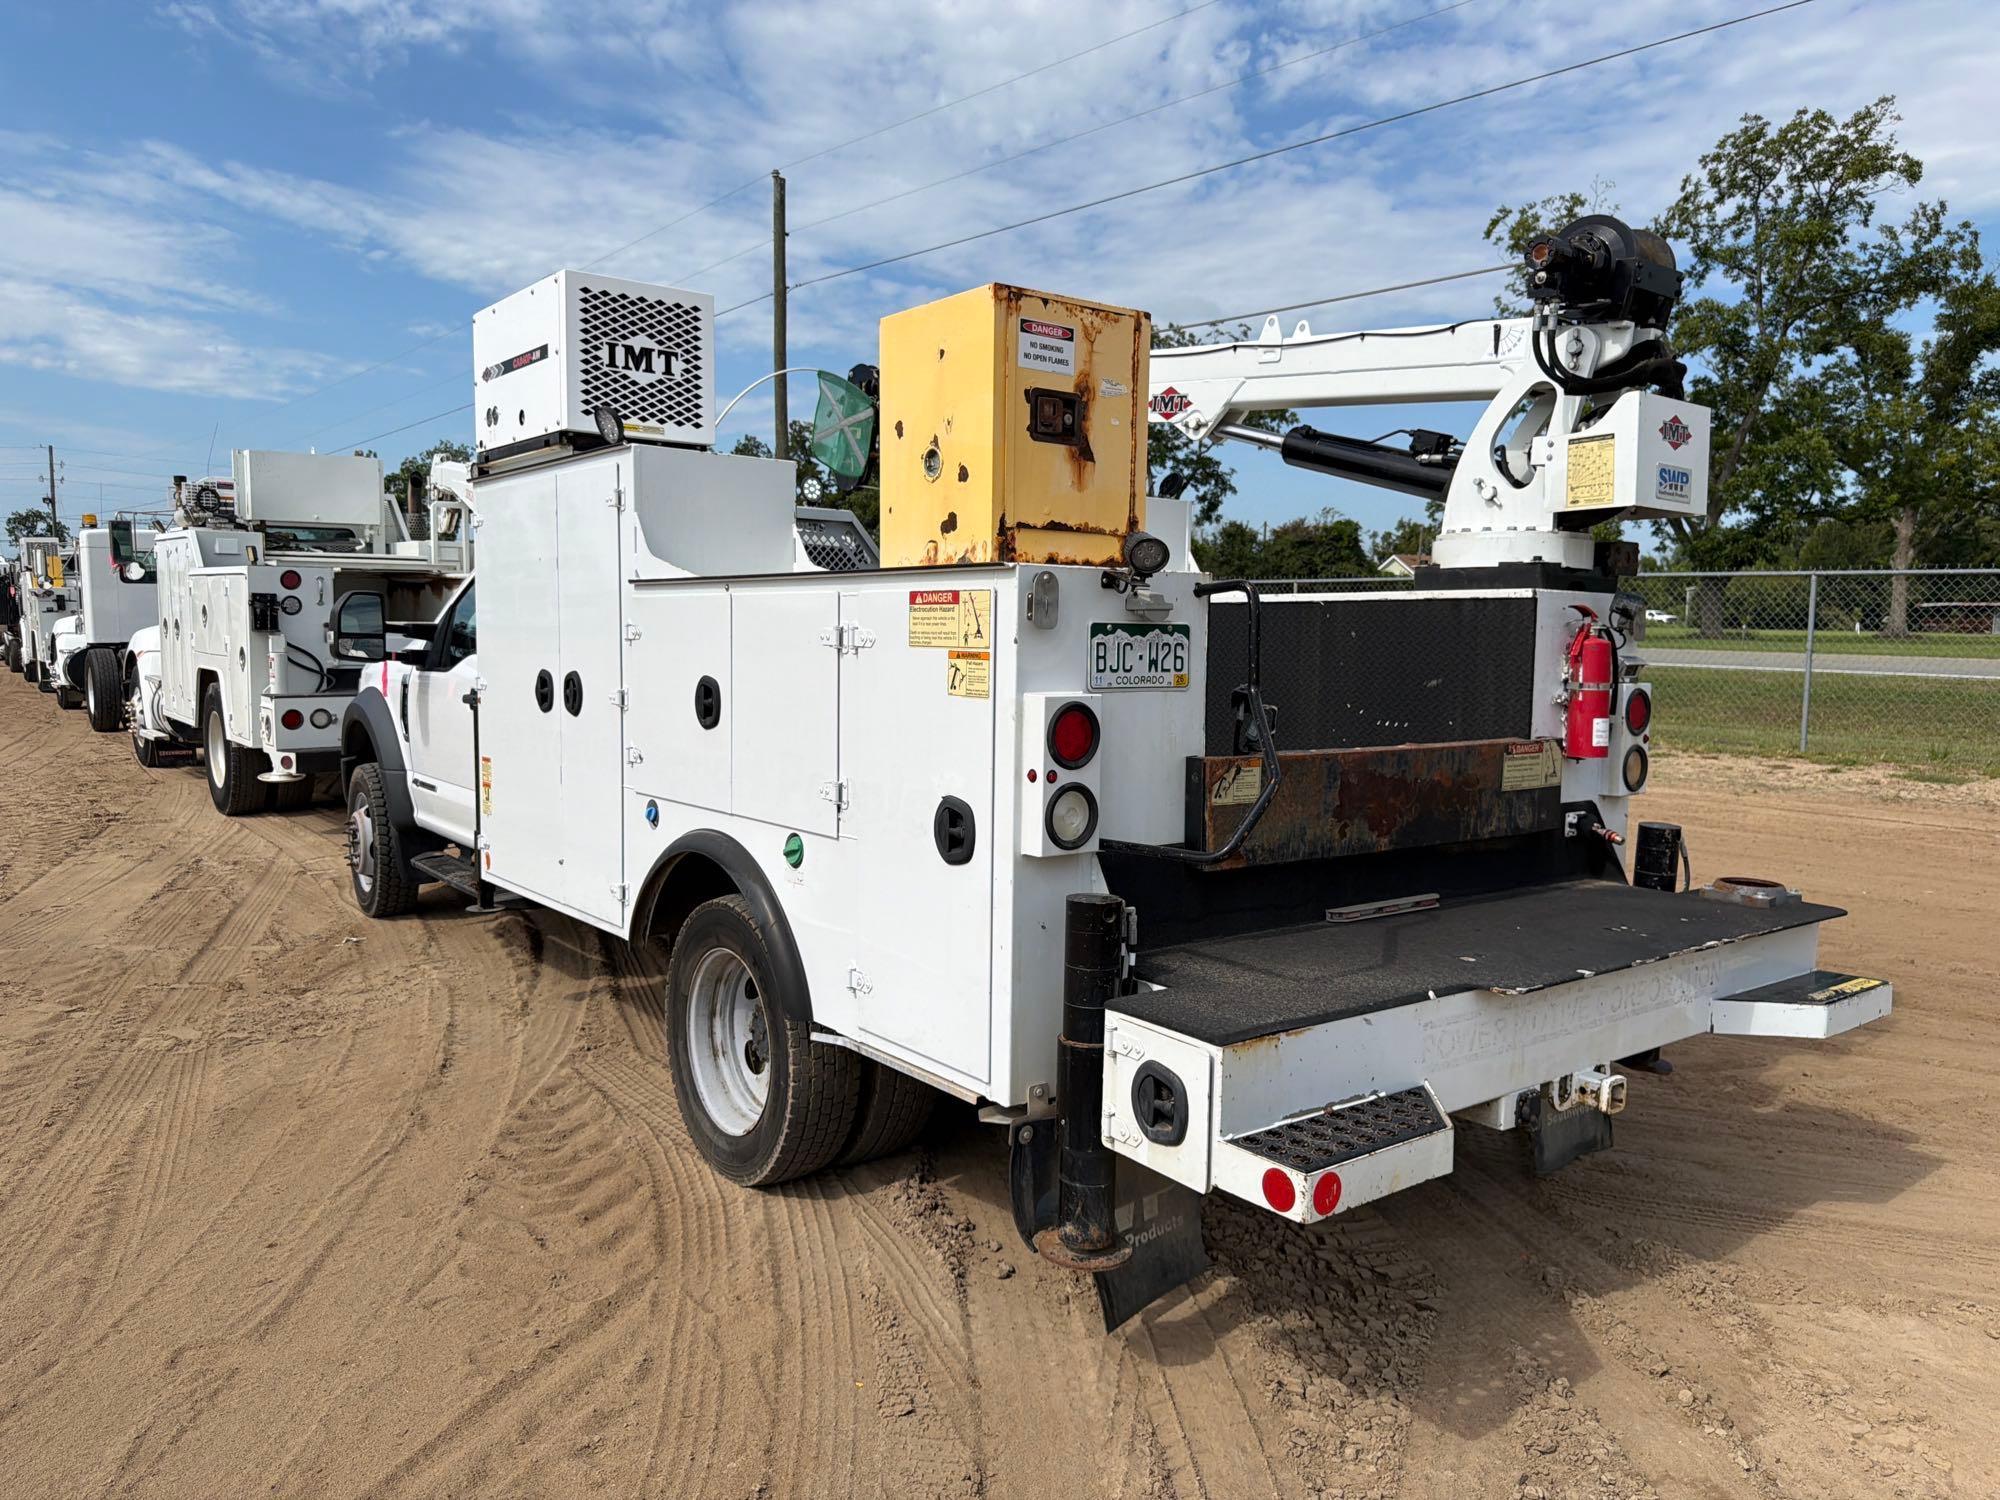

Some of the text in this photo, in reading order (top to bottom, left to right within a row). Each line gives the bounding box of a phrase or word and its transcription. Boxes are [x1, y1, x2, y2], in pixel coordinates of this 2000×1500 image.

[1031, 323, 1063, 337] DANGER
[1029, 341, 1064, 354] NO SMOKING
[604, 341, 679, 378] IMT
[1023, 352, 1069, 367] NO OPEN FLAMES
[1152, 394, 1188, 412] IMT
[1662, 420, 1689, 444] IMT
[922, 593, 953, 604] DANGER
[1115, 675, 1165, 685] COLORADO
[1125, 1215, 1184, 1247] Products
